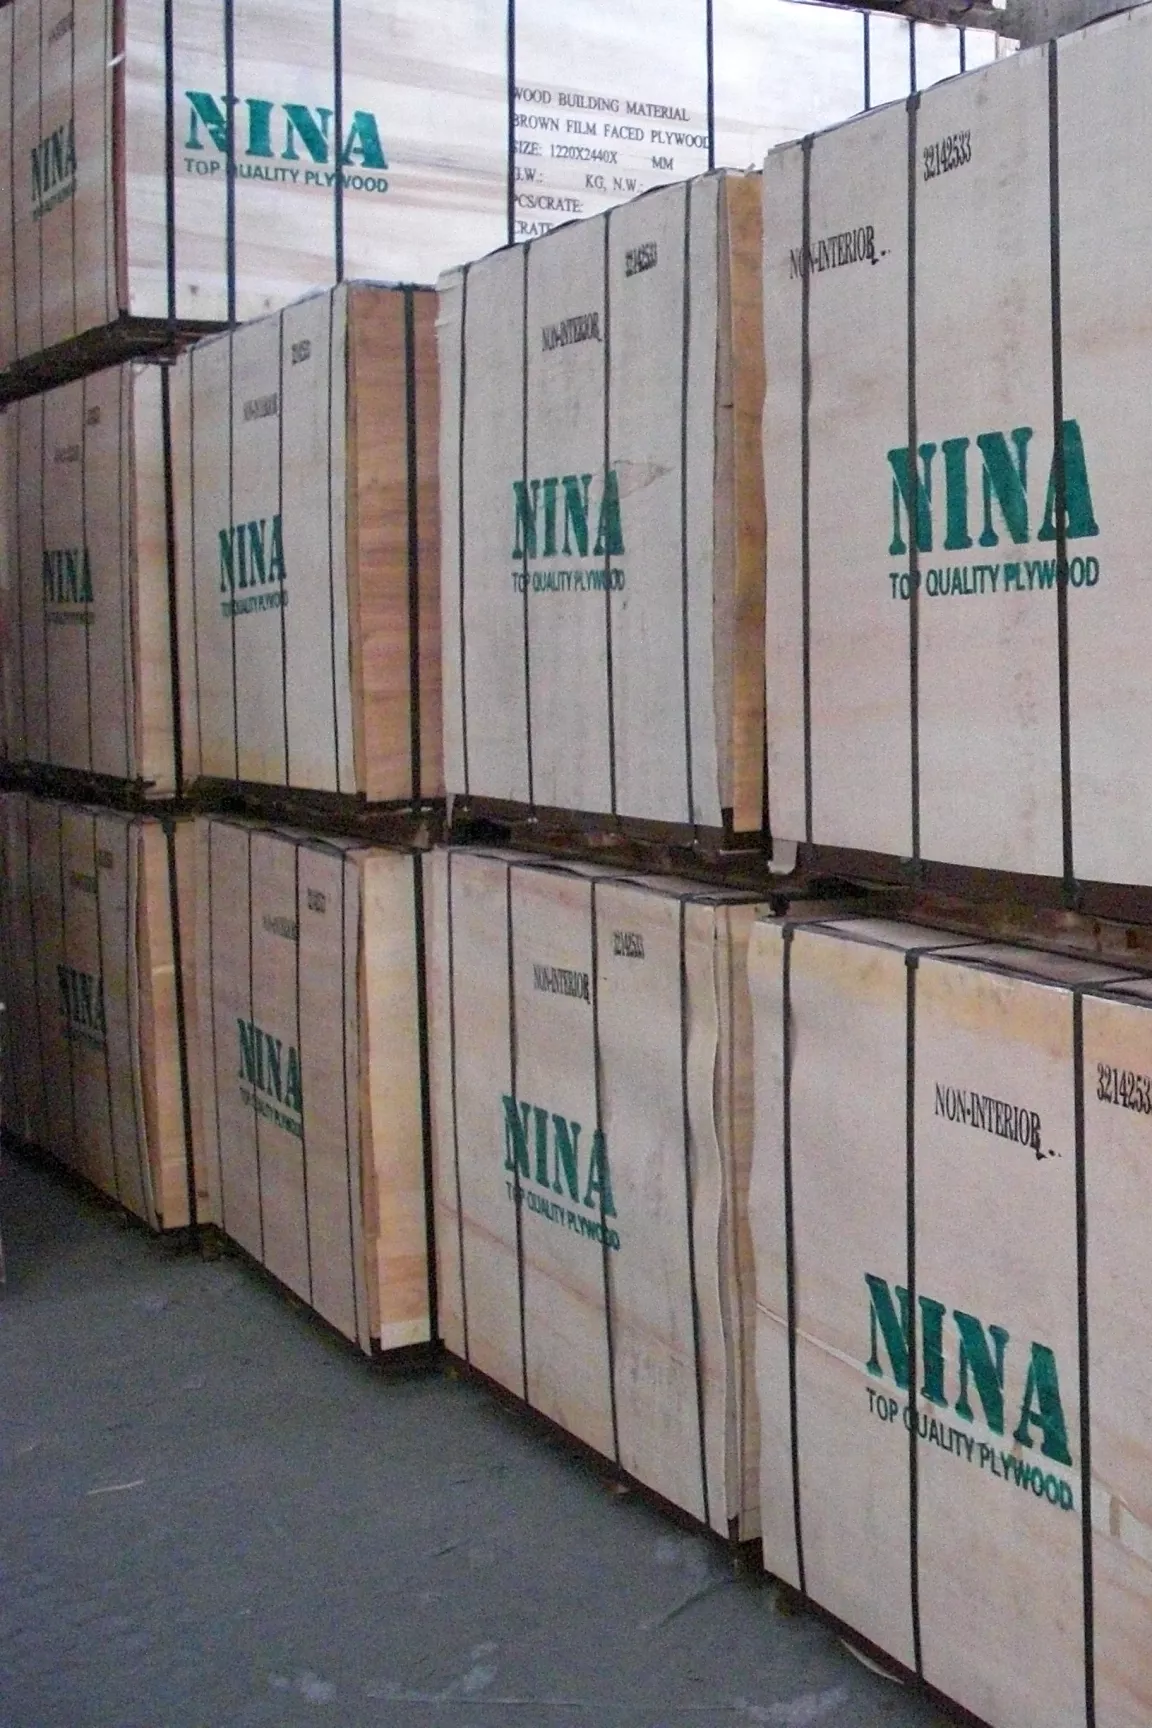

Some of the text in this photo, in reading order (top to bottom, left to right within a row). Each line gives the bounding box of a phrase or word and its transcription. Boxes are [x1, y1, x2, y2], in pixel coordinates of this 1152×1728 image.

[185, 91, 388, 169] NINA
[558, 92, 620, 113] BUILDING
[626, 102, 691, 122] MATERIAL
[566, 119, 597, 136] FILM
[604, 123, 644, 141] FACED
[651, 130, 710, 149] PLYWOOD
[184, 158, 221, 175] TOP
[229, 163, 299, 182] UALITY
[550, 144, 618, 164] 1220X2440X
[652, 155, 674, 170] MM
[790, 225, 875, 280] NN-INTERIOR
[512, 469, 625, 560] NINA
[887, 419, 1099, 555] NINA
[43, 548, 94, 603] NINA
[219, 513, 287, 593] NINA
[572, 567, 626, 591] PLYWOD
[889, 556, 1100, 600] TO QUALITY PLYWOD
[237, 1017, 303, 1114] NINA
[934, 1081, 1043, 1152] NON-INTERIOR
[502, 1095, 618, 1219] NINA
[566, 1209, 621, 1252] PLYWOD
[865, 1272, 1073, 1467] NINA
[866, 1387, 899, 1424] TOP
[977, 1441, 1075, 1512] PLYWOOD
